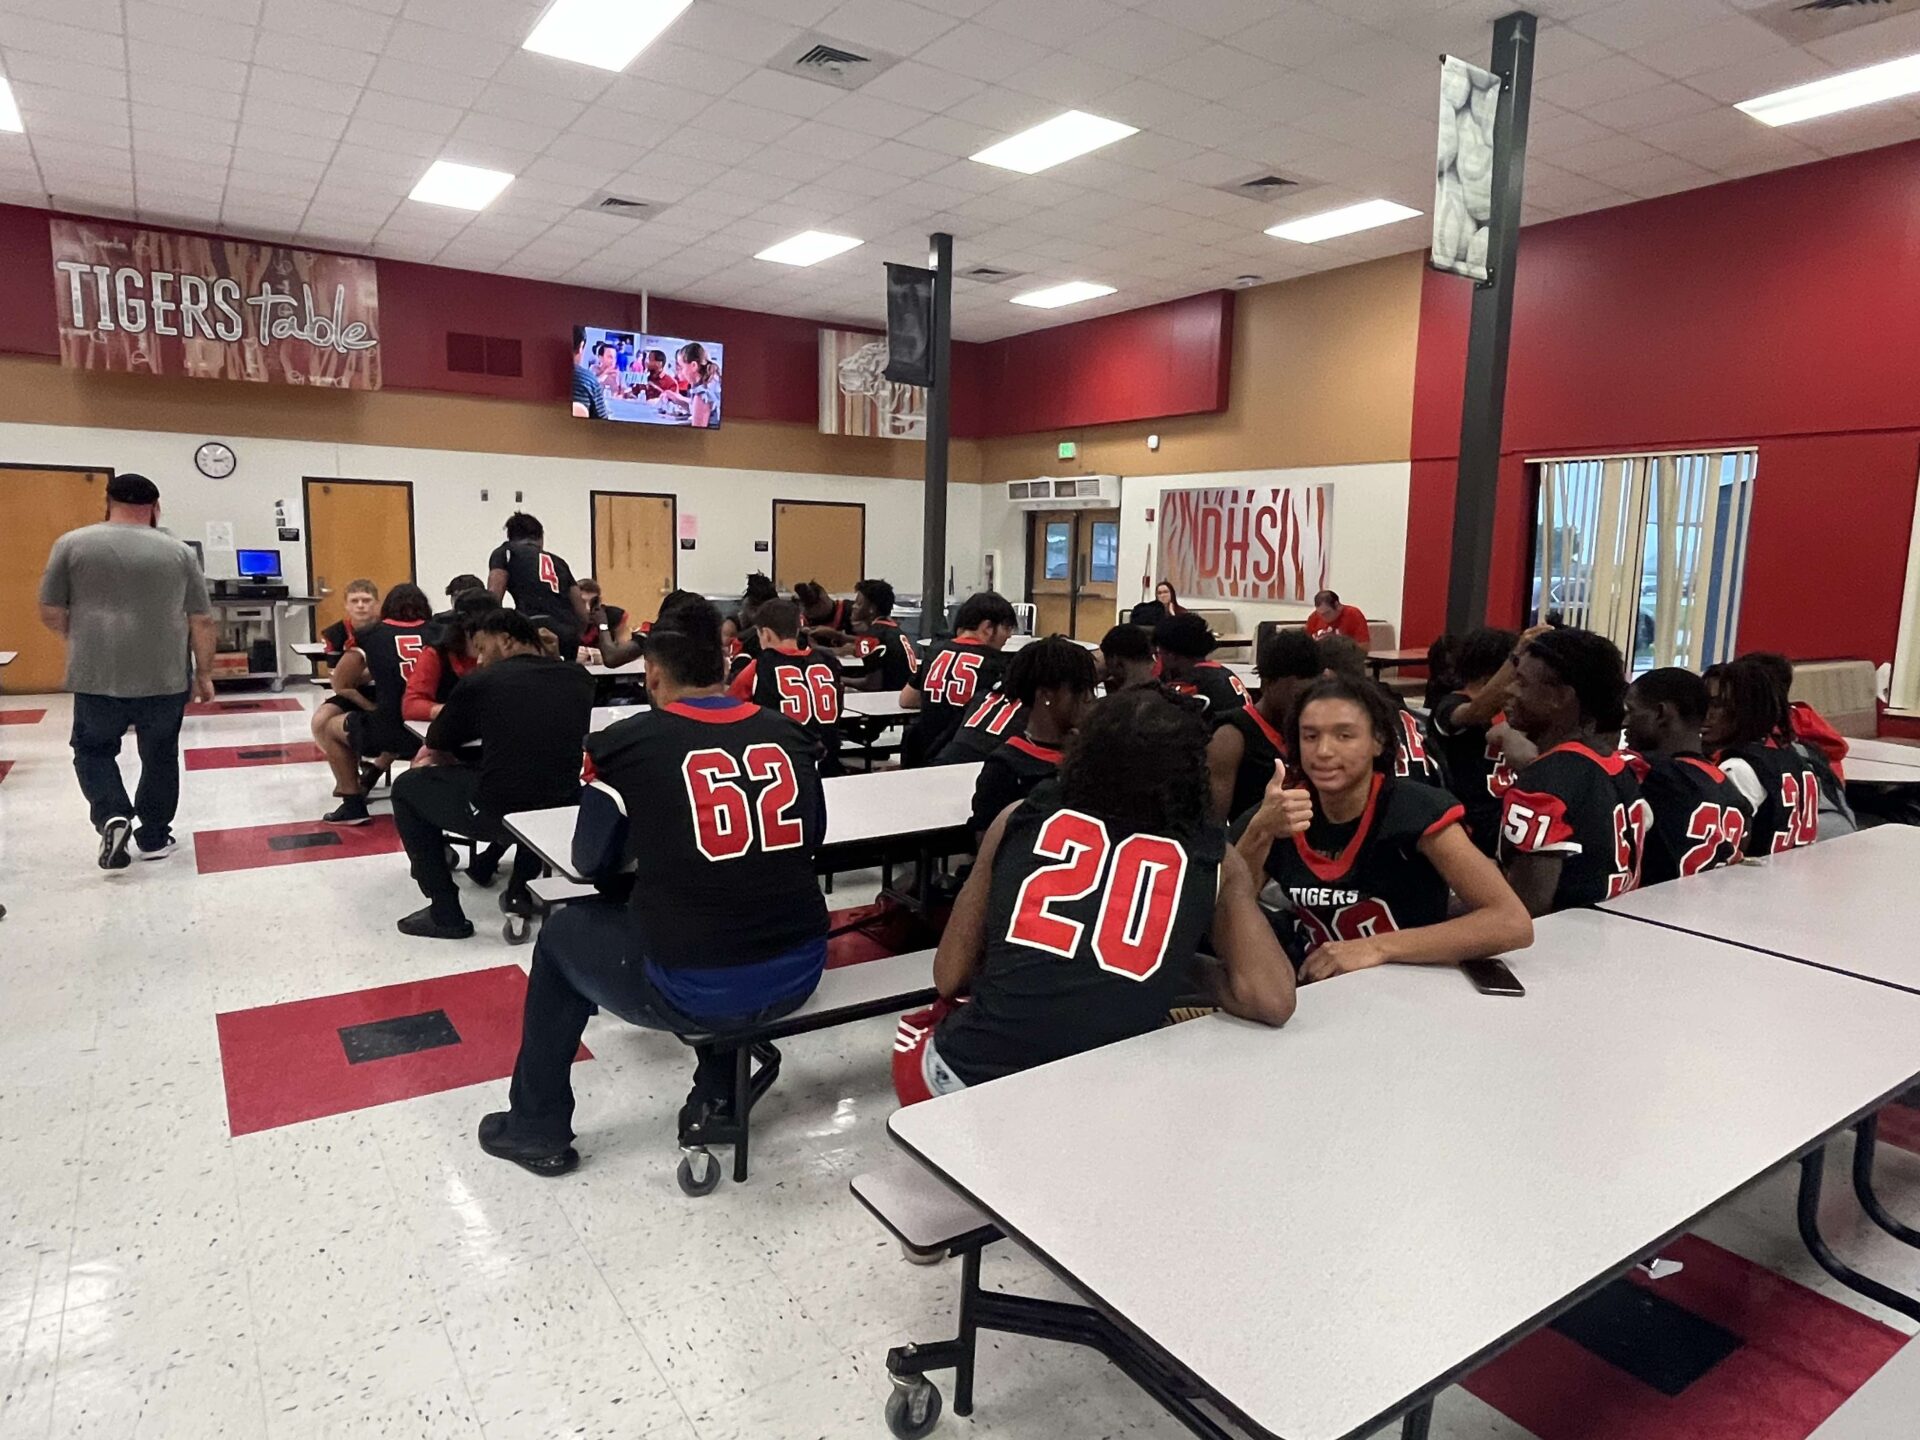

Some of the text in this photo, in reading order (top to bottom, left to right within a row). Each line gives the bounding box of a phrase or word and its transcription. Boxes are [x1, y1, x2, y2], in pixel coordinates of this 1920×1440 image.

[57, 261, 242, 342] TIGERS
[246, 281, 378, 354] table
[539, 553, 559, 593] 4
[860, 640, 870, 655] 6
[775, 664, 839, 725] 56
[923, 650, 984, 706] 45
[681, 742, 803, 861] 62
[1504, 803, 1551, 850] 51
[1771, 770, 1819, 855] 30
[1005, 809, 1189, 983] 20
[1289, 887, 1360, 907] TIGERS
